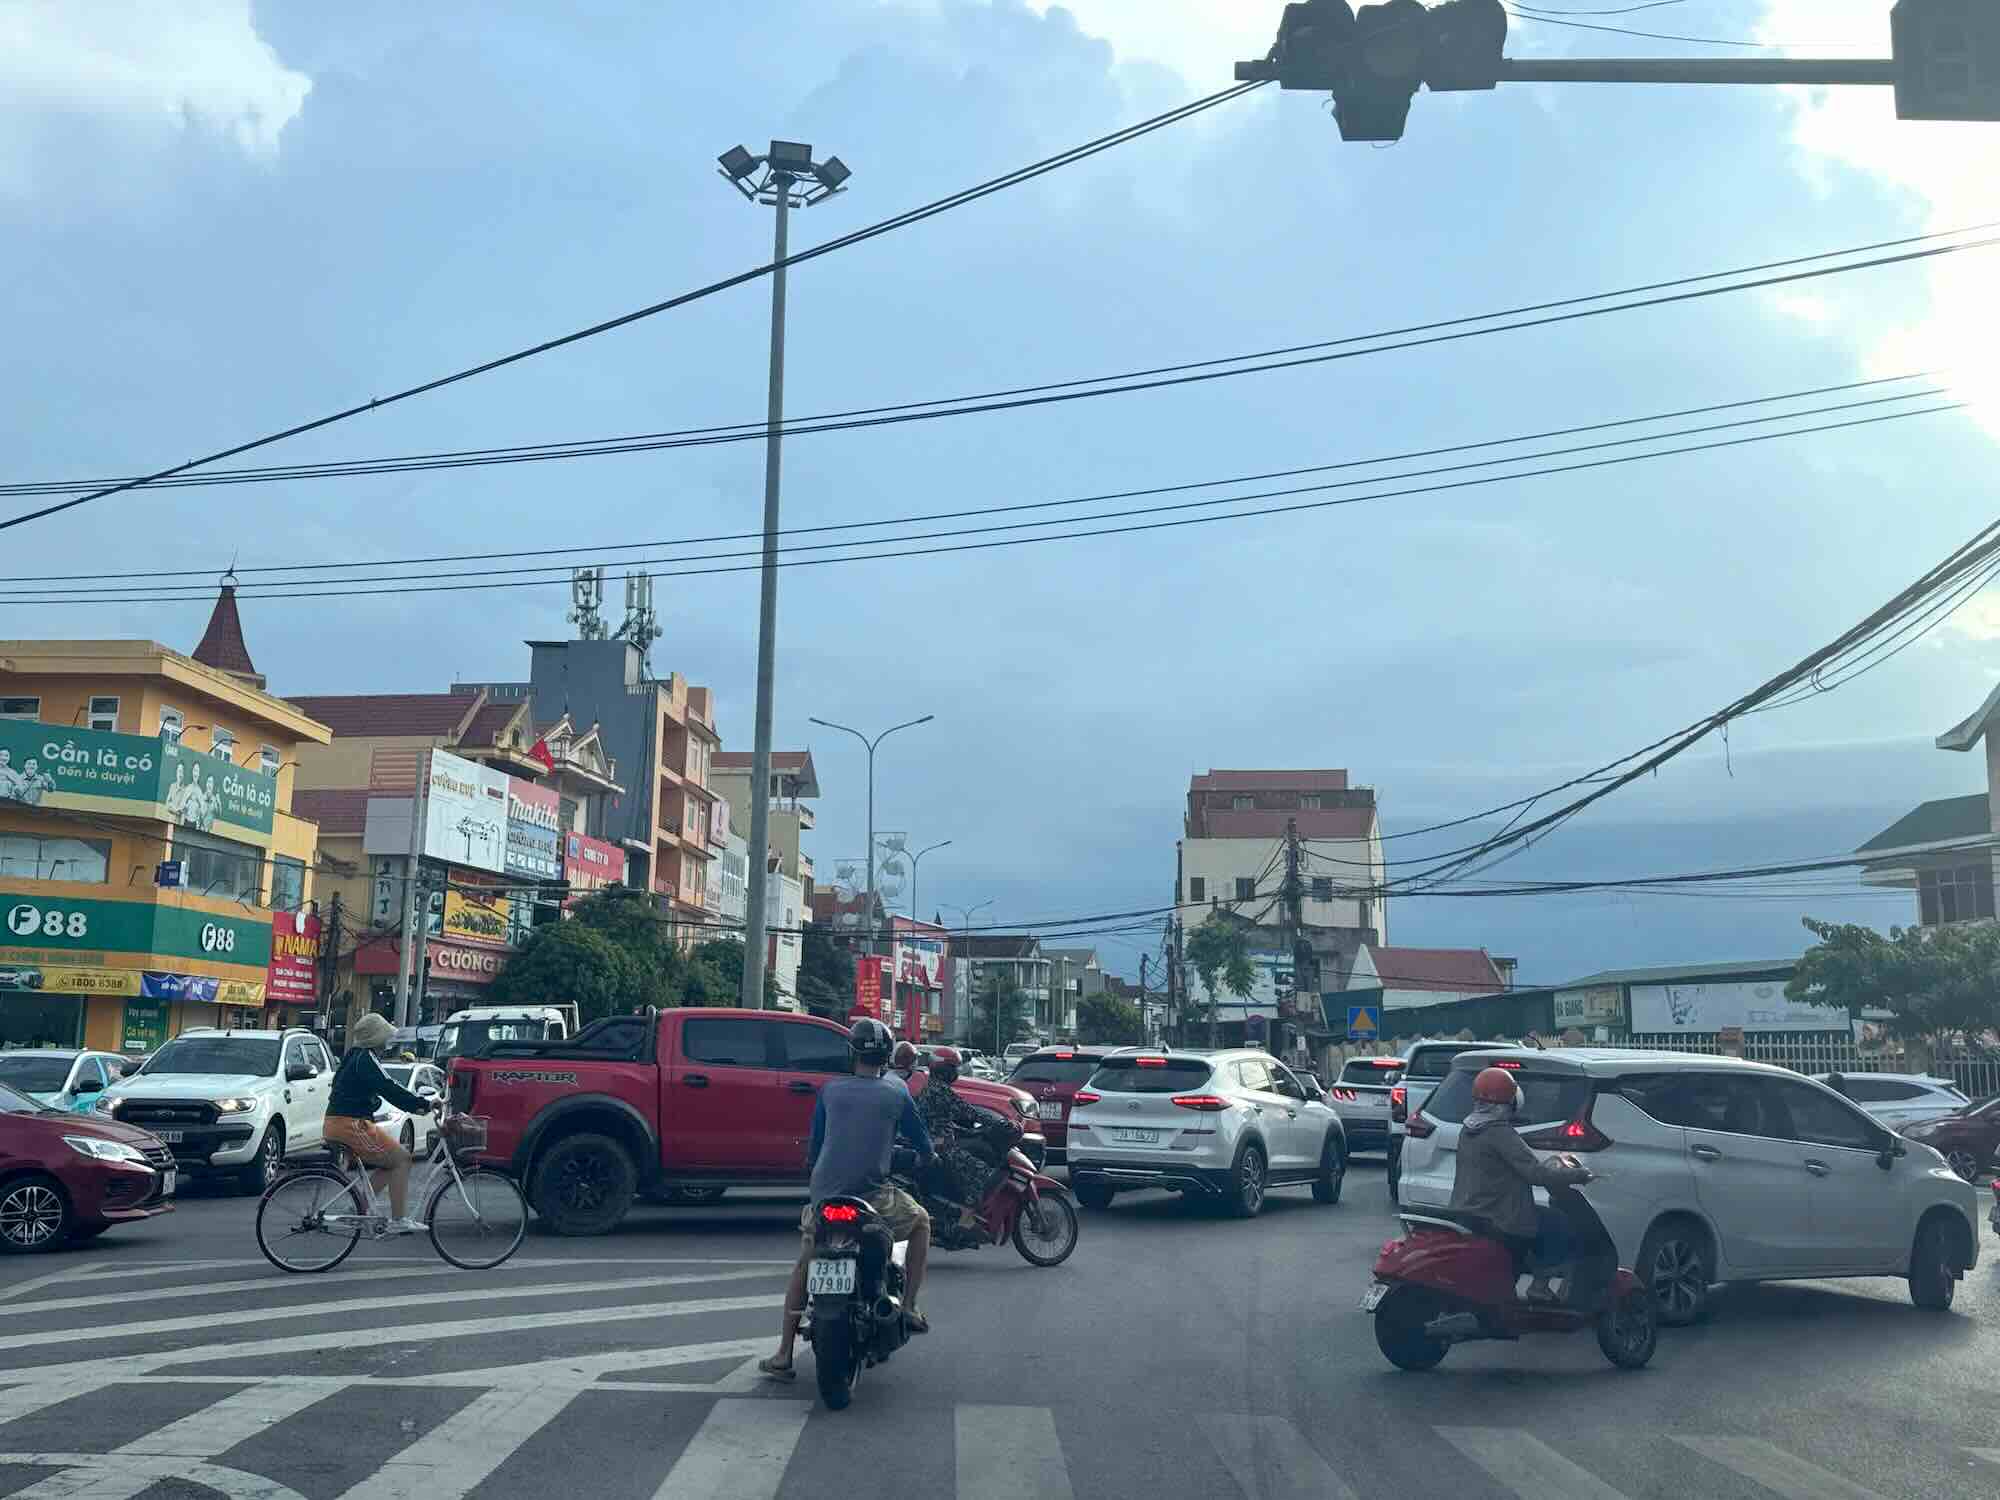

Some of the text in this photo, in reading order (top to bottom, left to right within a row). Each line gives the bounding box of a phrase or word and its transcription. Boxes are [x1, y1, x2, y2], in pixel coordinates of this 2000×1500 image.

[42, 740, 153, 772] Cần là có
[7, 904, 88, 938] F88
[201, 922, 235, 952] F88
[491, 1071, 582, 1088] RAPTOR
